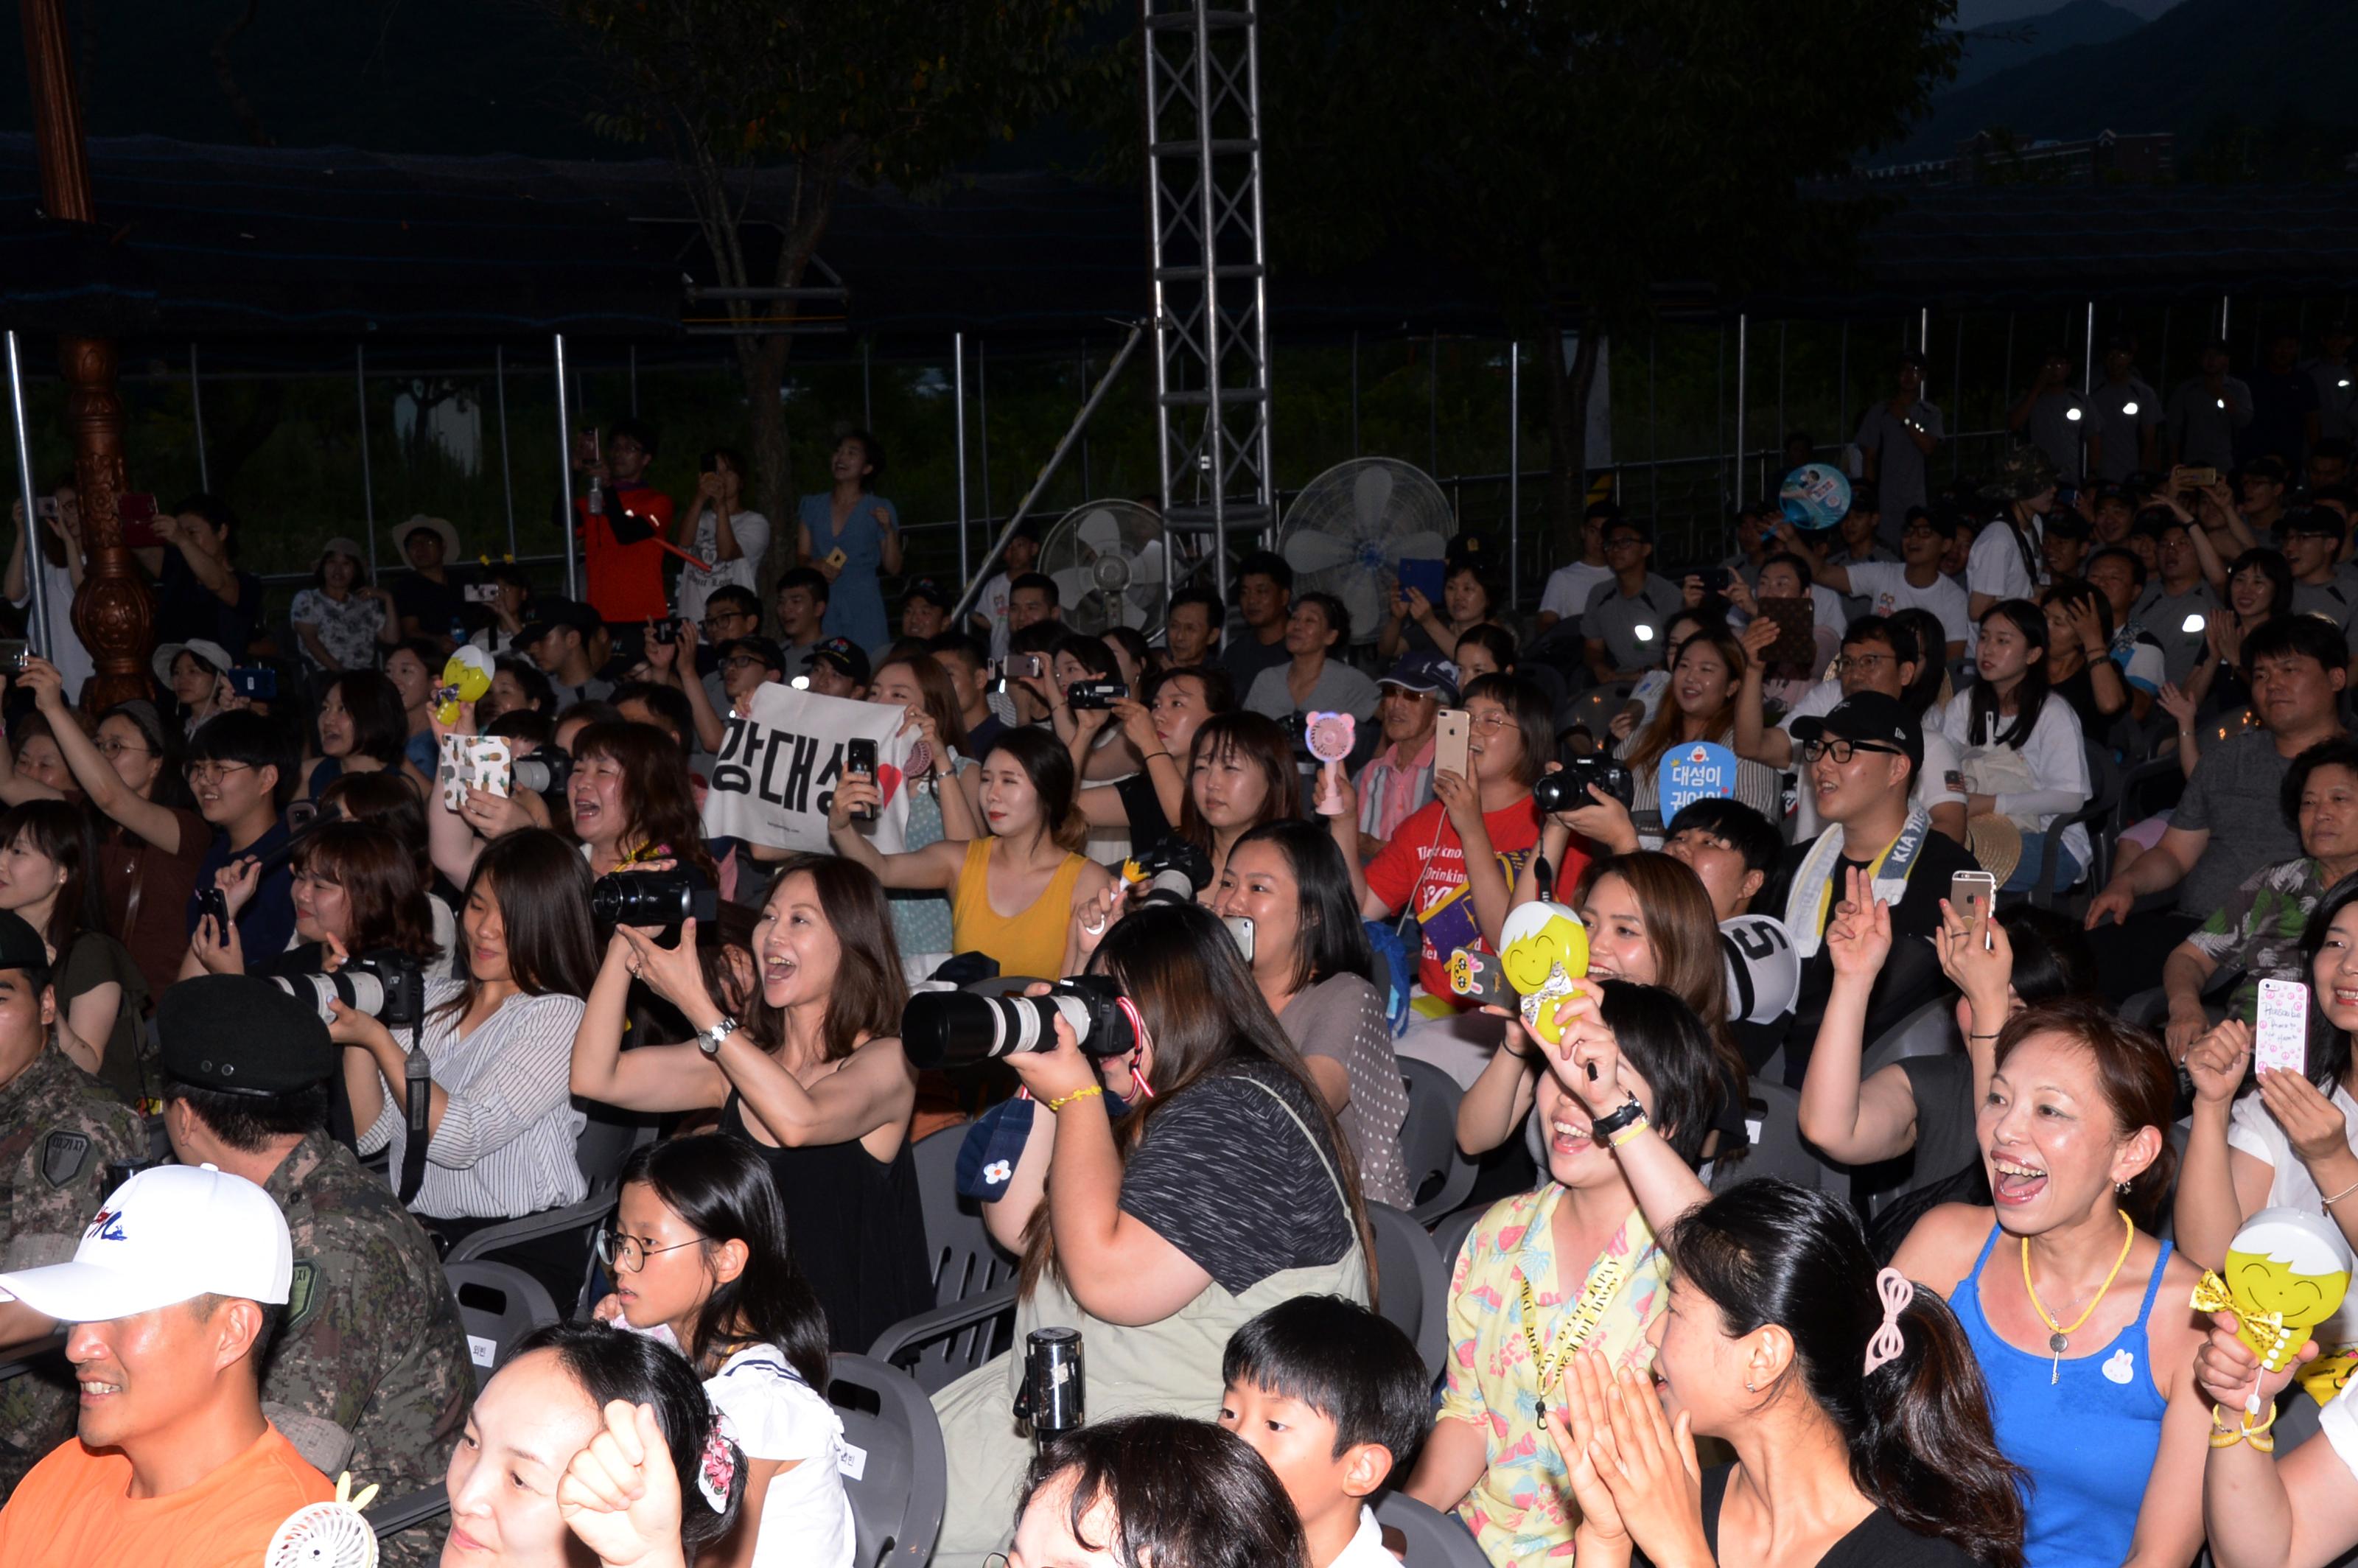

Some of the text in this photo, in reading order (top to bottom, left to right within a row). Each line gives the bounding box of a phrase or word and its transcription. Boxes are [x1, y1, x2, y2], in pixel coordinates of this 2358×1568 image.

[1672, 766, 1721, 787] 대성이
[1892, 836, 1917, 862] KIA
[1424, 867, 1467, 883] Drinkin
[1525, 1326, 1540, 1357] 2017
